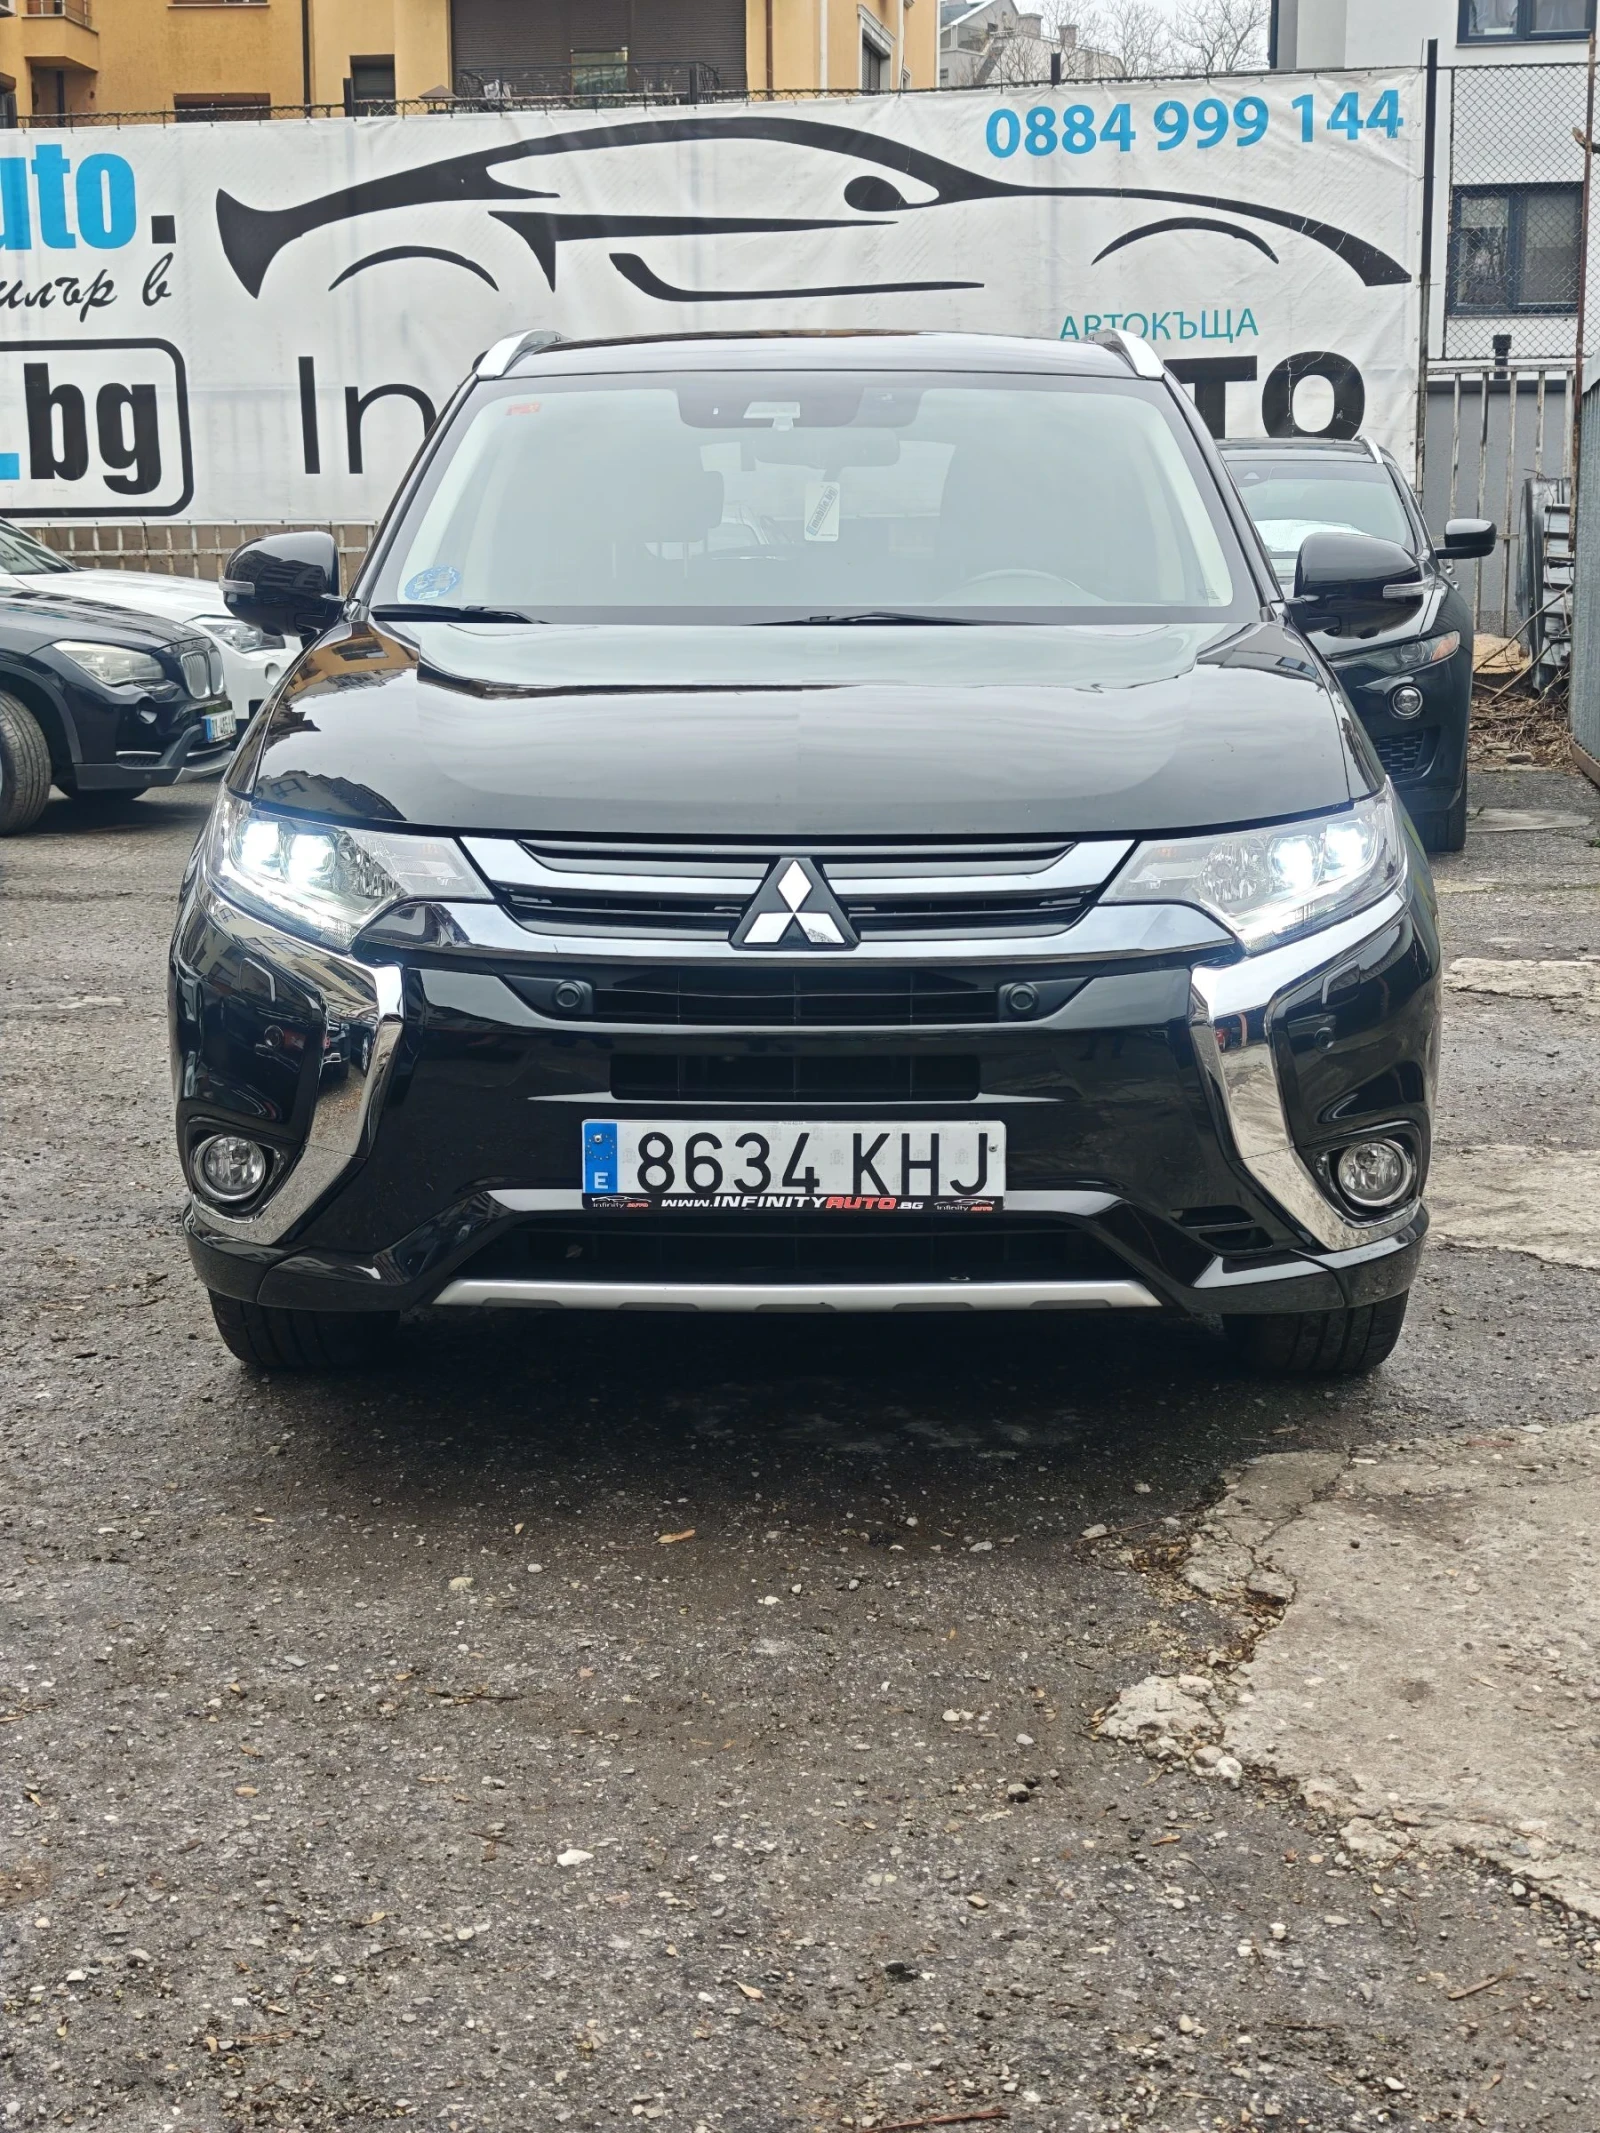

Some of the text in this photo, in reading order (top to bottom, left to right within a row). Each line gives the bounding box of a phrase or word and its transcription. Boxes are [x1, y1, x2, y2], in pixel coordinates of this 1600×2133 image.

[985, 89, 1404, 158] 0884 999 144
[594, 1172, 609, 1189] E
[637, 1131, 989, 1196] 8634 KHJ
